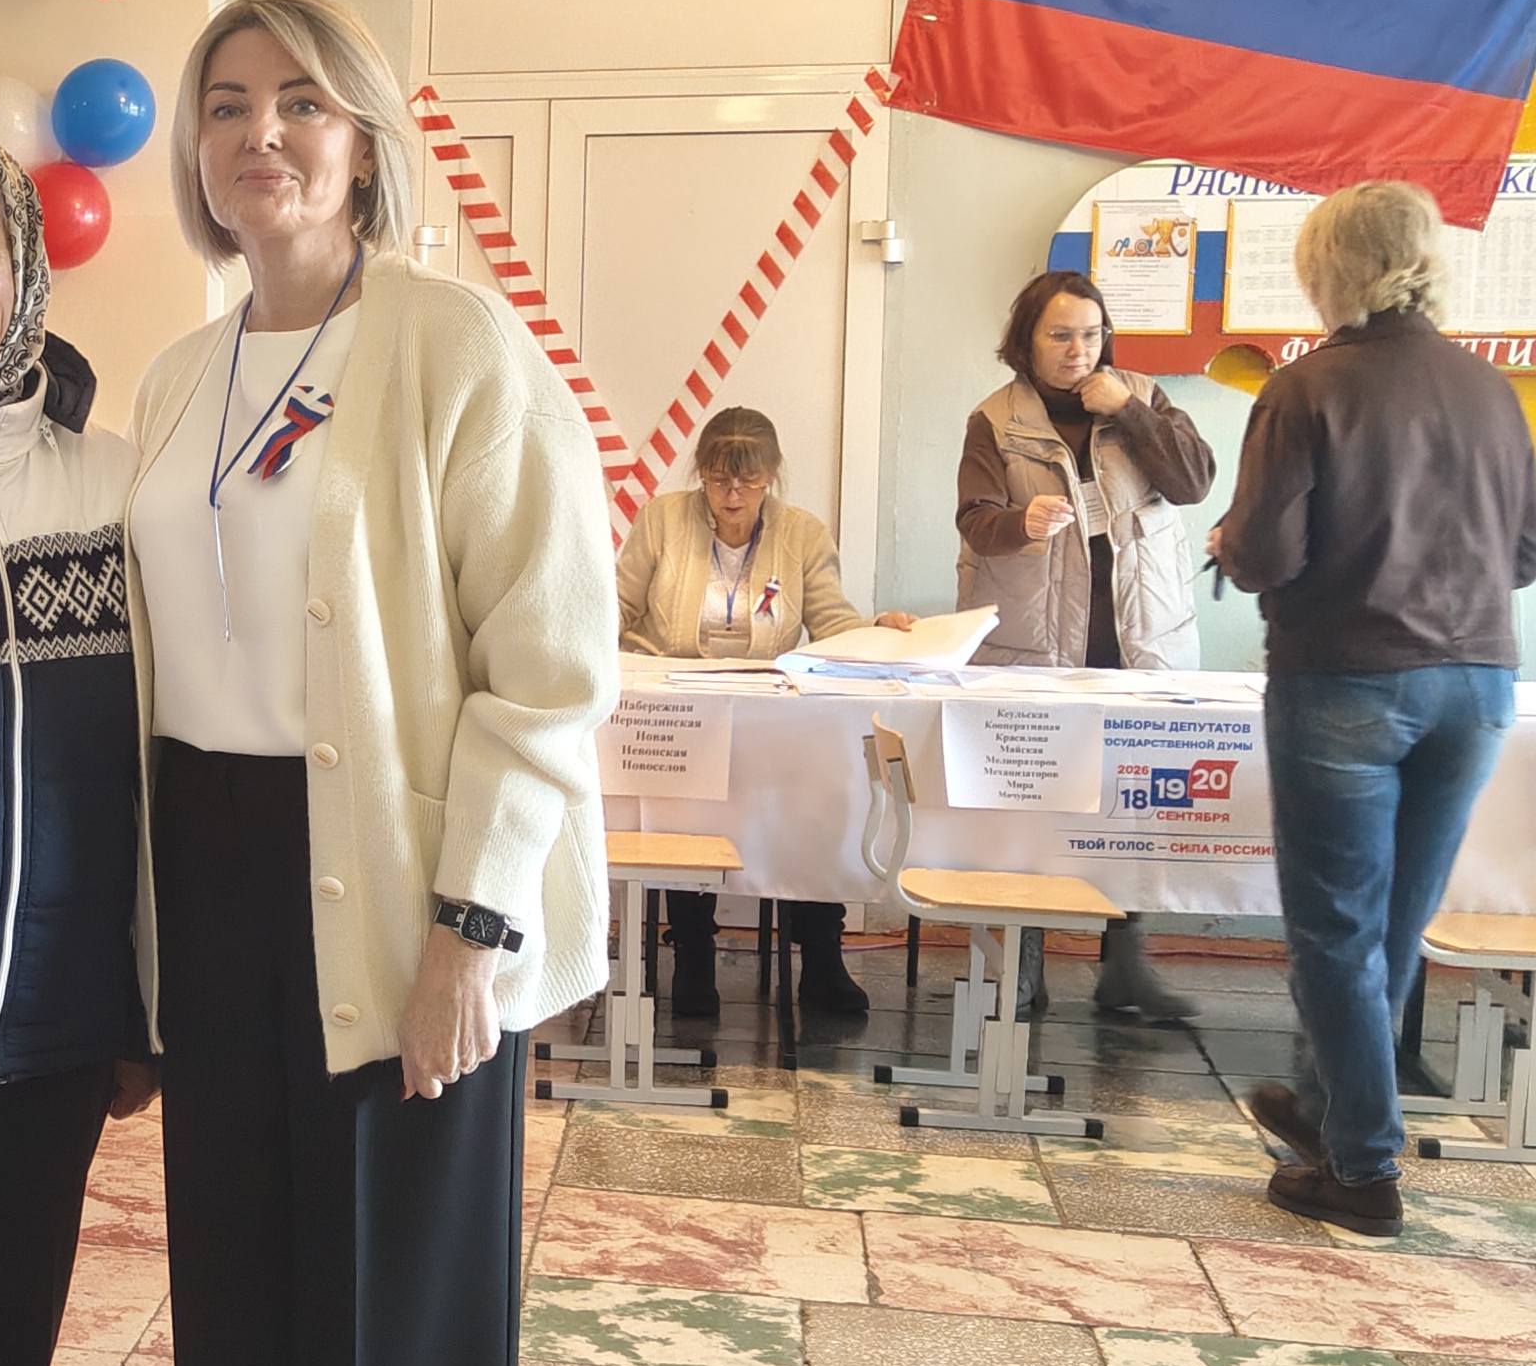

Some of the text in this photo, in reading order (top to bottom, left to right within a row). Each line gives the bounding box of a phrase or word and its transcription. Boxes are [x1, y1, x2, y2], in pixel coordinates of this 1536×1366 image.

[619, 699, 694, 714] Набережная
[1103, 718, 1252, 735] ВЫБОРЫ ДЕПУТАТОВ
[636, 730, 674, 742] Новая
[999, 744, 1044, 755] Майская
[1216, 741, 1254, 752] ДУМЫ
[622, 759, 687, 773] Новоселов
[1117, 764, 1150, 776] 2026
[1006, 779, 1034, 792] Мира
[1120, 768, 1229, 810] 18 19 20
[1155, 810, 1231, 823] СЕНТЯБРЯ
[1068, 837, 1106, 851] ТВОЙ
[1109, 839, 1156, 852] ГОЛОС
[1169, 842, 1210, 855] СИЛА
